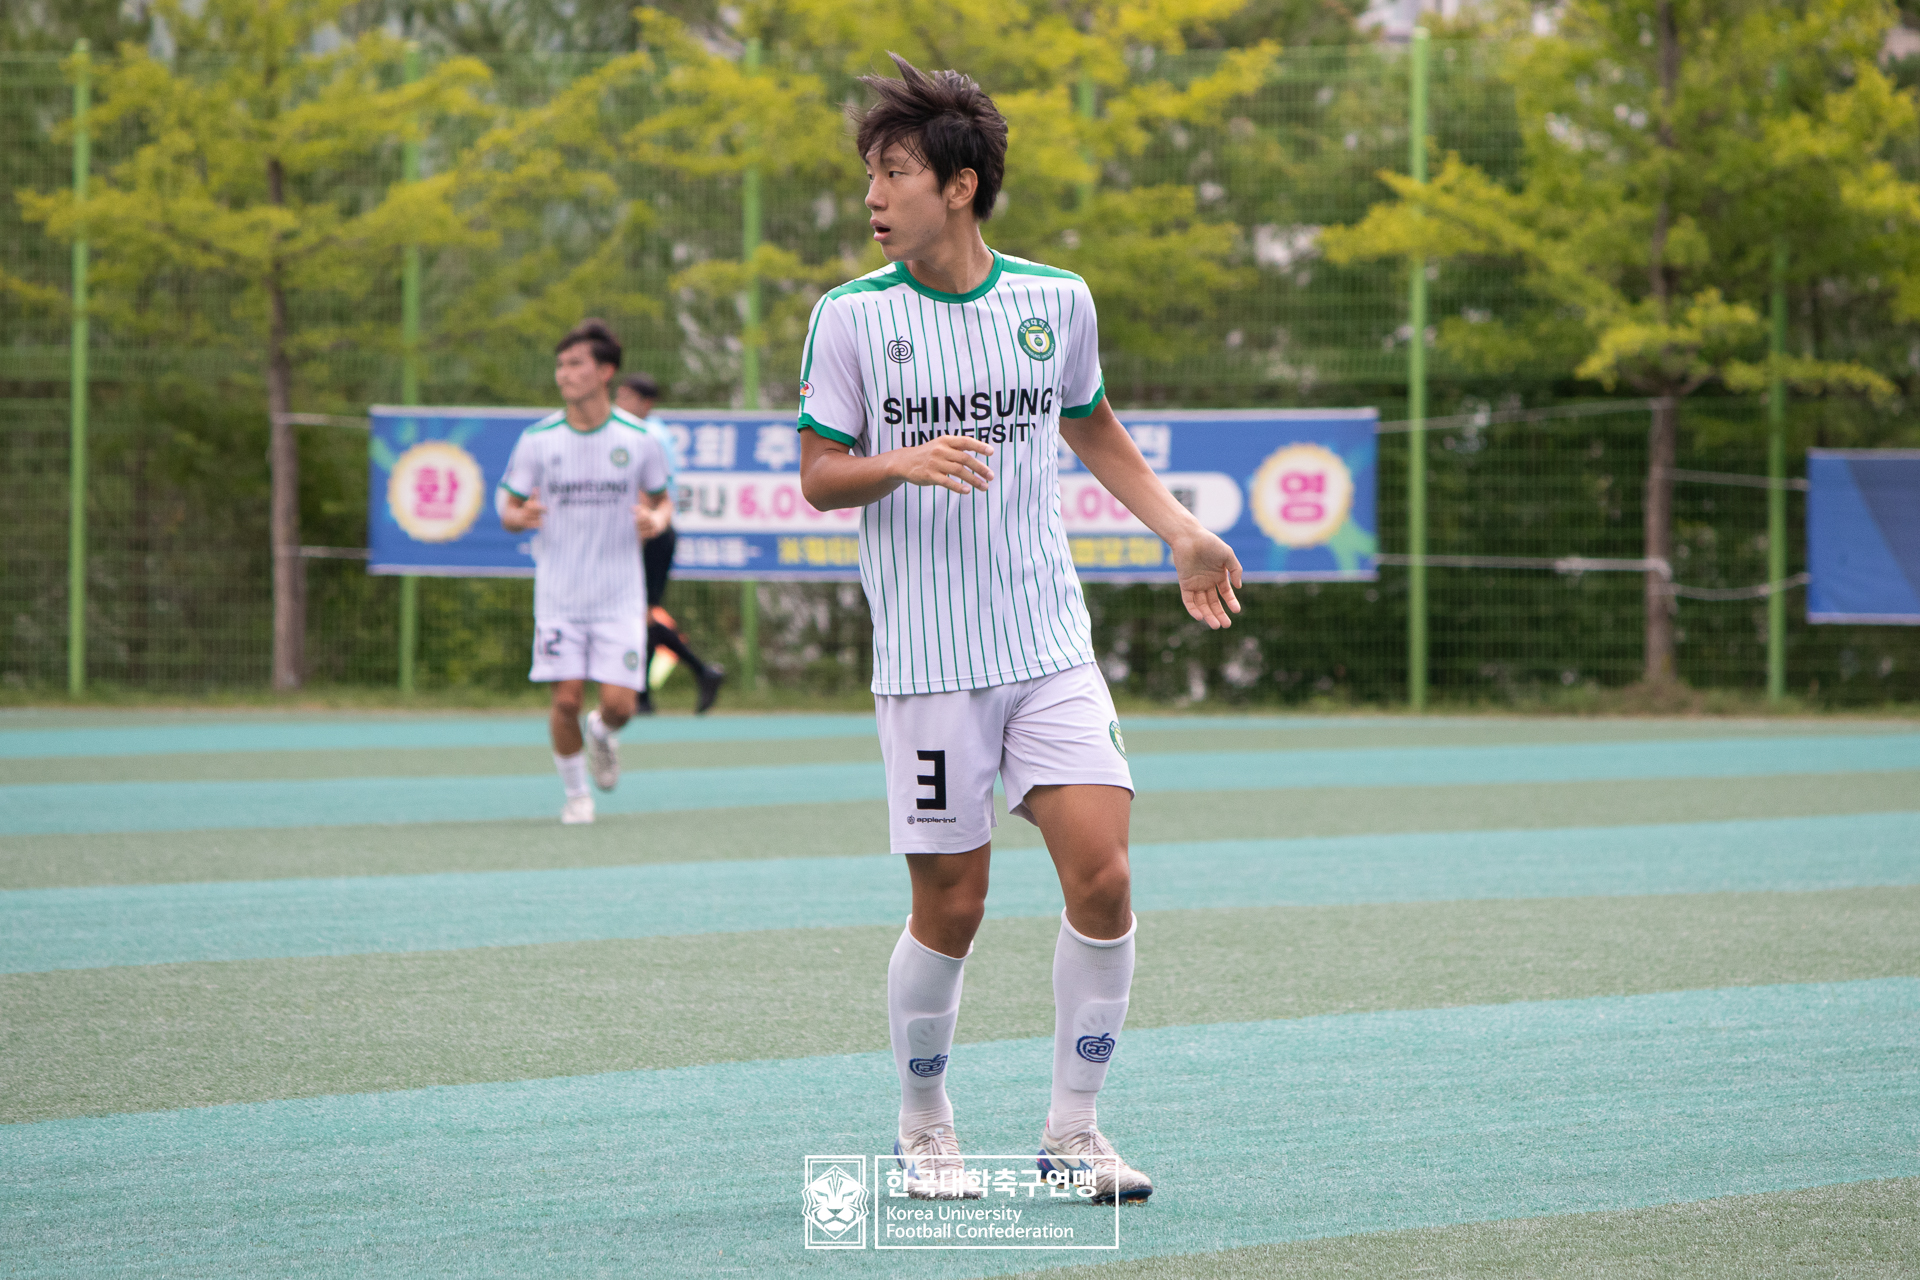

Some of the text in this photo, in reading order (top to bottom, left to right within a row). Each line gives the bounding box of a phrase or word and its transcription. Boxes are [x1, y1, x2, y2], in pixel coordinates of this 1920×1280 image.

[883, 387, 1053, 425] SHINSUNG
[1279, 470, 1326, 524] 영
[916, 750, 947, 810] 3
[916, 816, 957, 824] applerind
